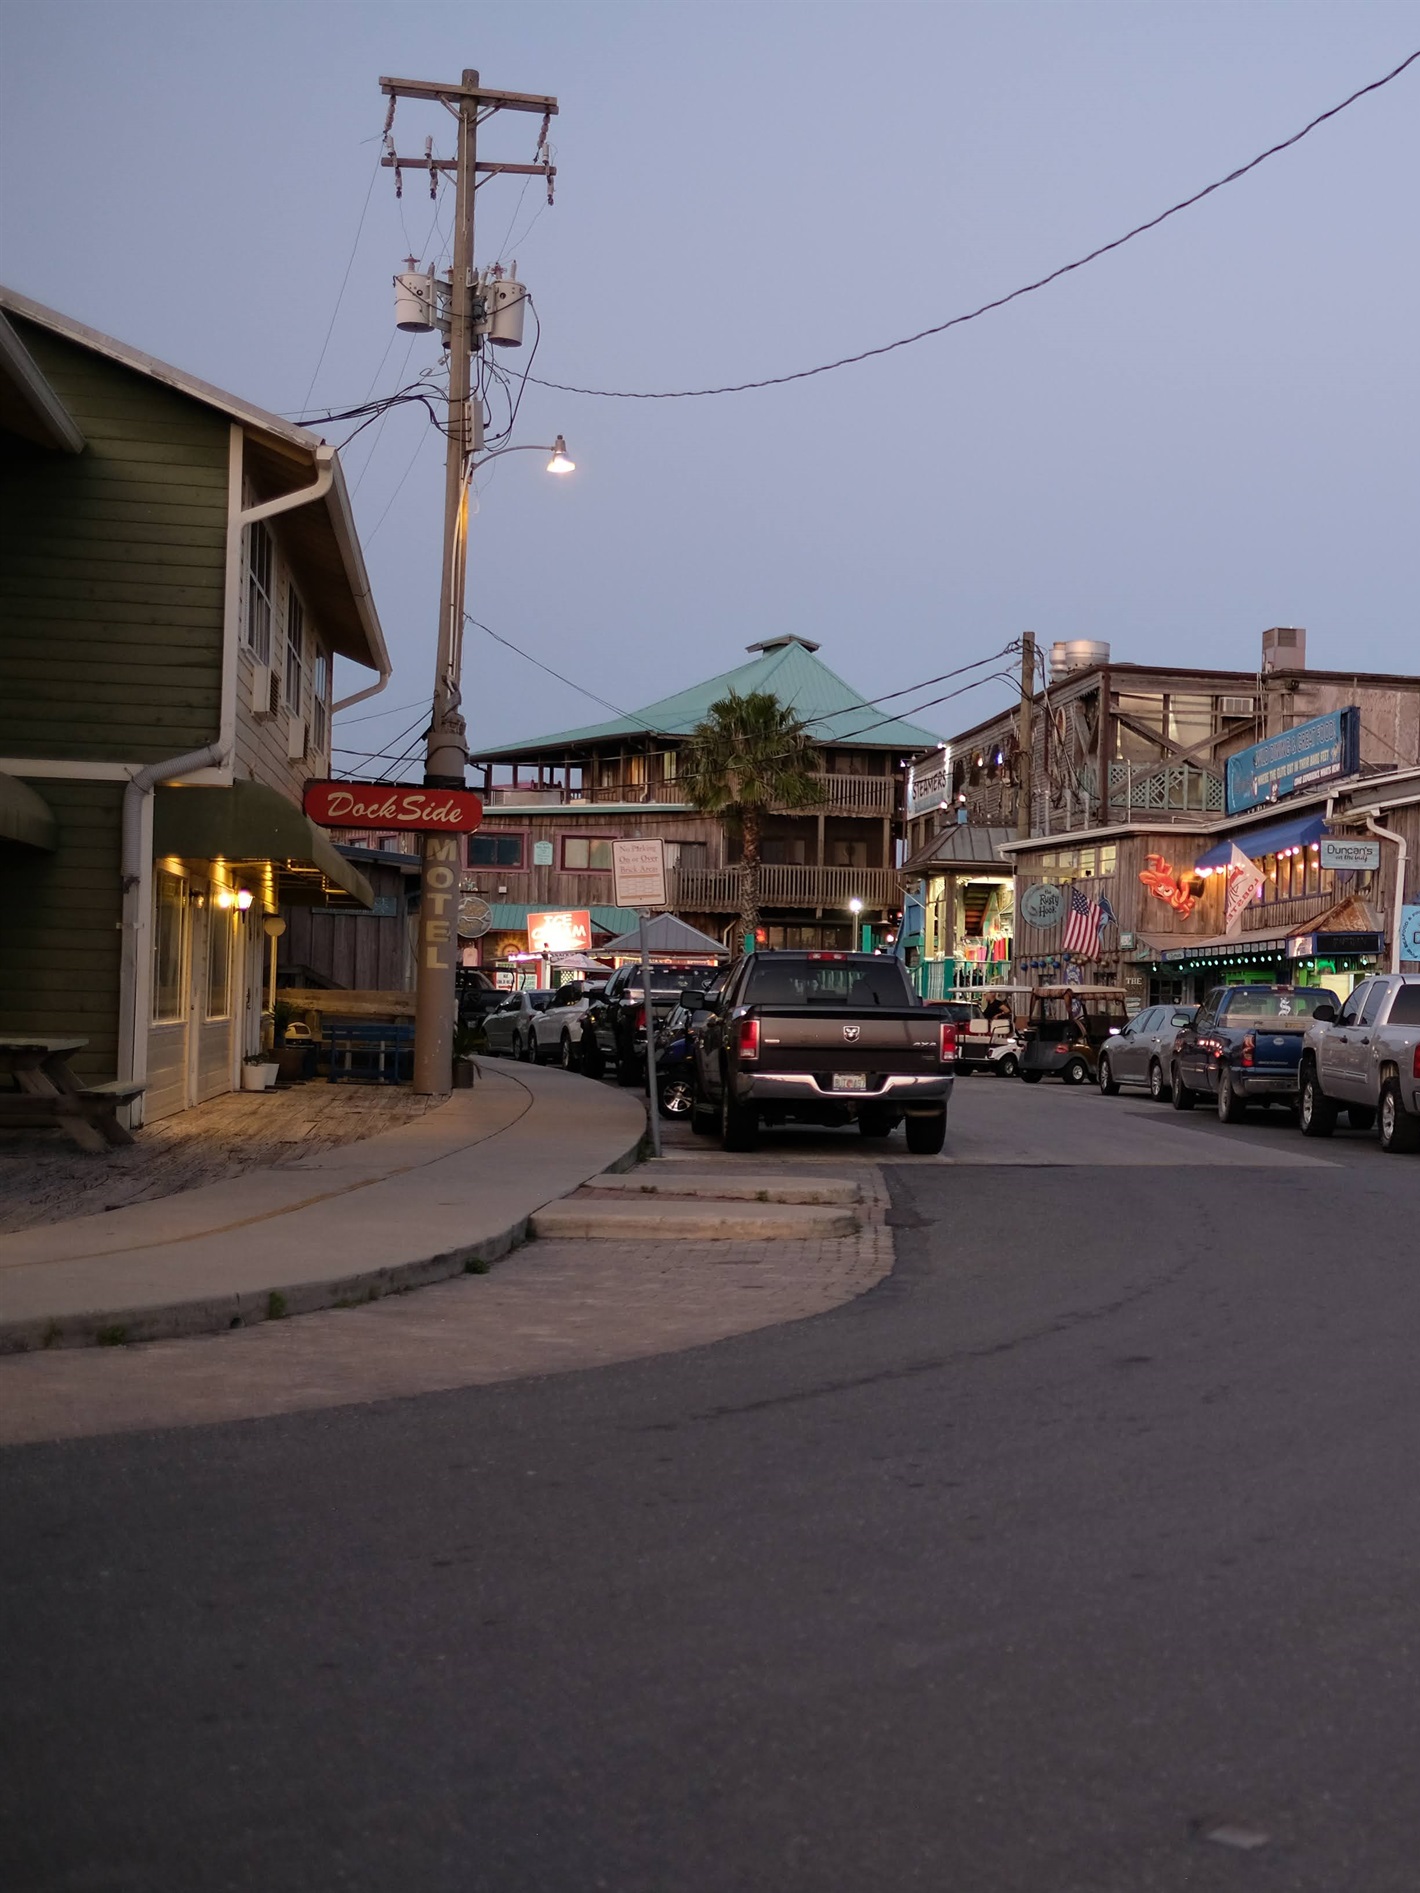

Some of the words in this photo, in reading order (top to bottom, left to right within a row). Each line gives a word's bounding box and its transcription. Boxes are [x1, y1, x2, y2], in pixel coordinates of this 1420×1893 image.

[912, 769, 947, 800] STEAMERS
[632, 844, 656, 853] Parking
[1327, 844, 1373, 855] Duncan's
[620, 856, 631, 864] On
[641, 855, 658, 863] Over
[621, 865, 637, 873] Brick
[641, 864, 659, 873] Areas
[426, 838, 457, 969] MOTEL
[1039, 894, 1060, 906] Rusty
[1039, 906, 1057, 917] Hook
